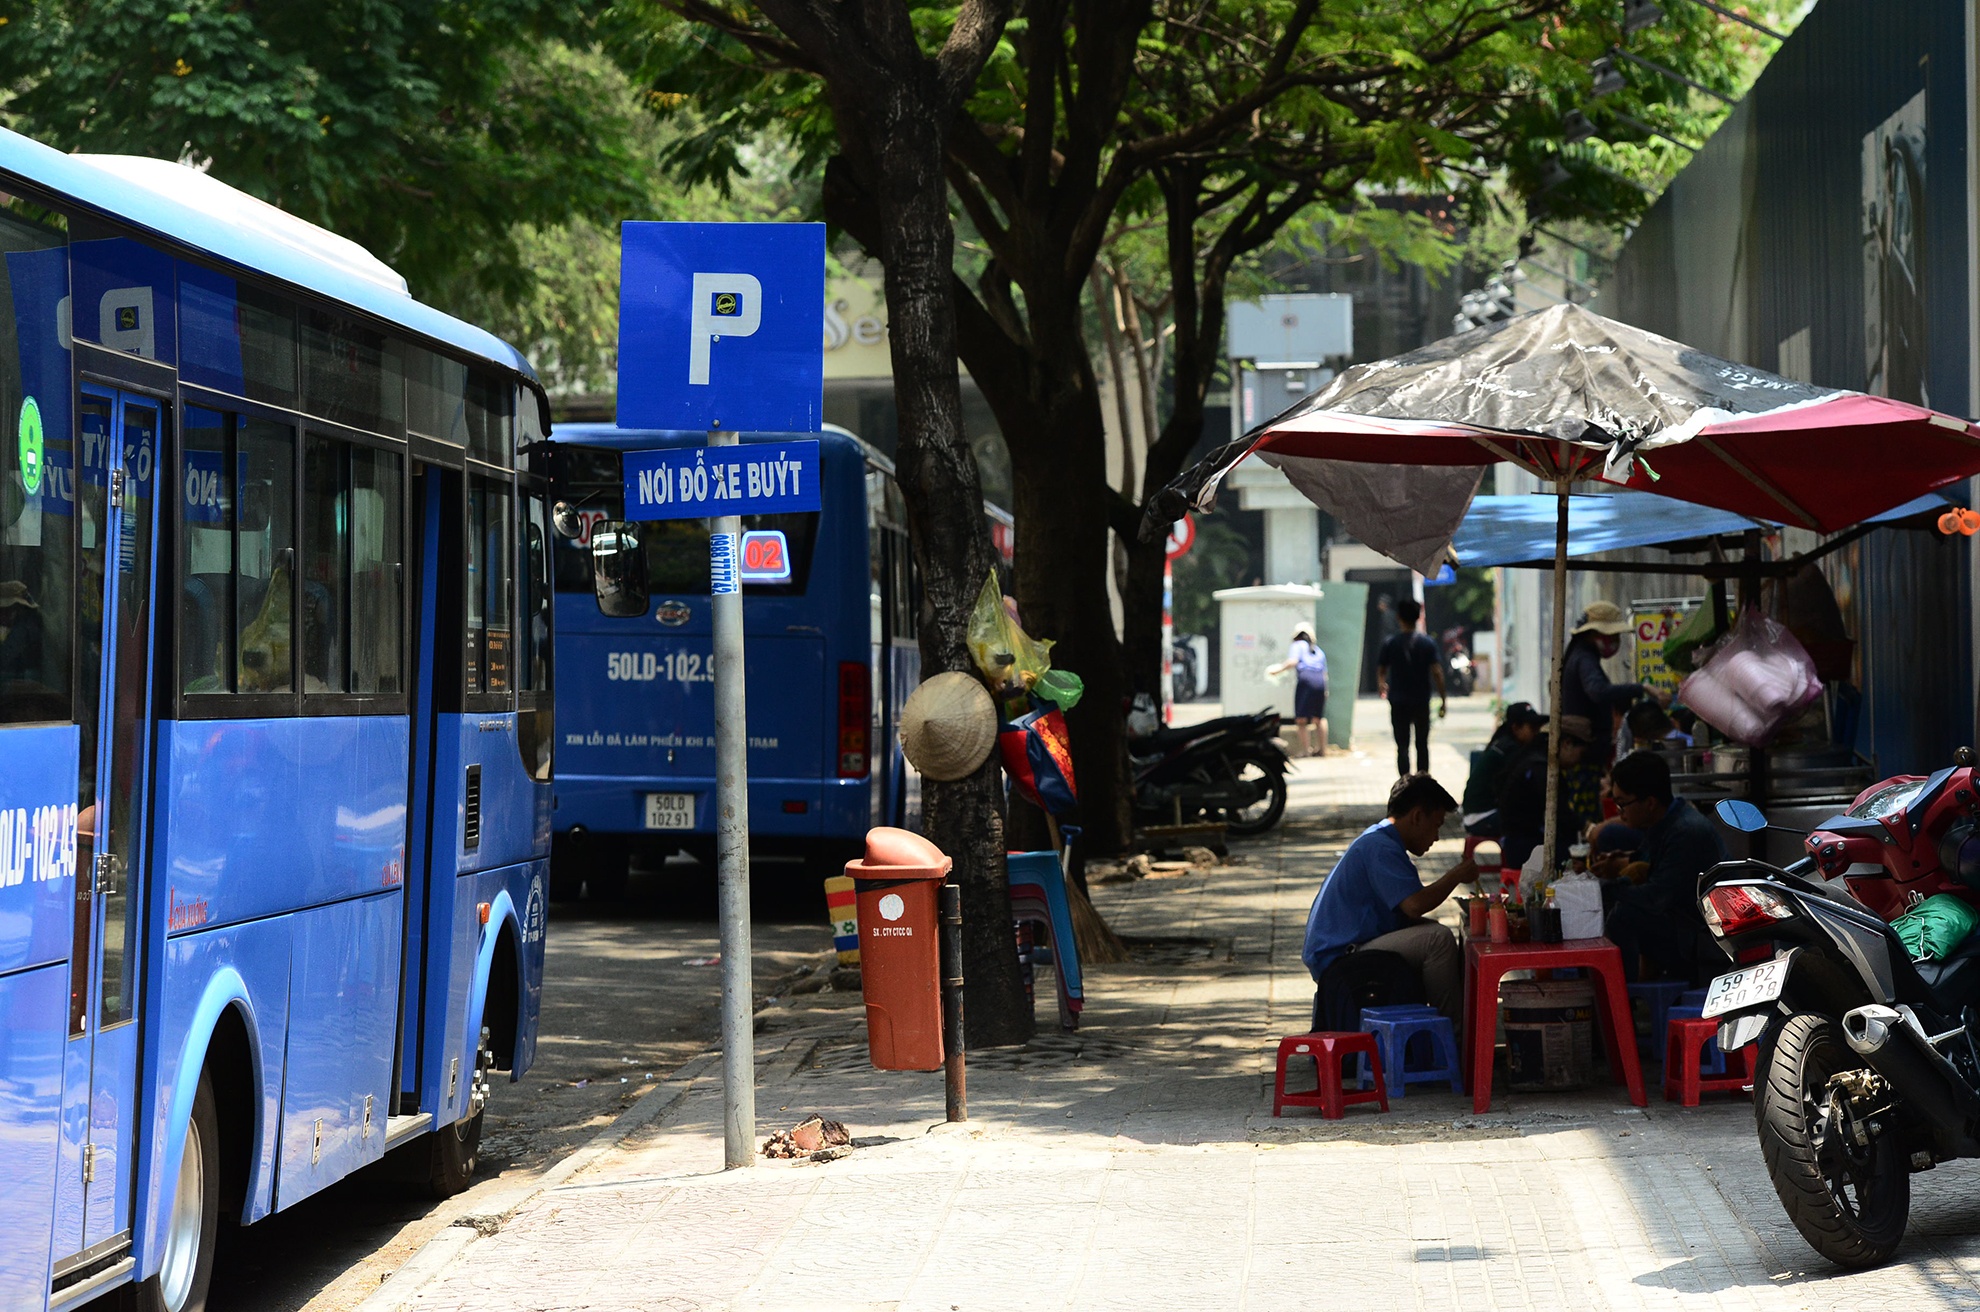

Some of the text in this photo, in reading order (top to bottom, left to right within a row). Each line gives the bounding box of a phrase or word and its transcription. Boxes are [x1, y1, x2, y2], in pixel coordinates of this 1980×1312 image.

[689, 272, 763, 385] P
[639, 449, 802, 505] NƠI ĐỖ XE BUÝT
[711, 534, 731, 594] 0988777742
[745, 540, 782, 569] 02
[1638, 620, 1682, 642] CA
[607, 652, 715, 682] 50LD-102.9
[566, 734, 584, 745] XIN
[685, 736, 703, 747] KHI
[656, 795, 686, 811] 50LD
[1721, 964, 1776, 993] 59-P2
